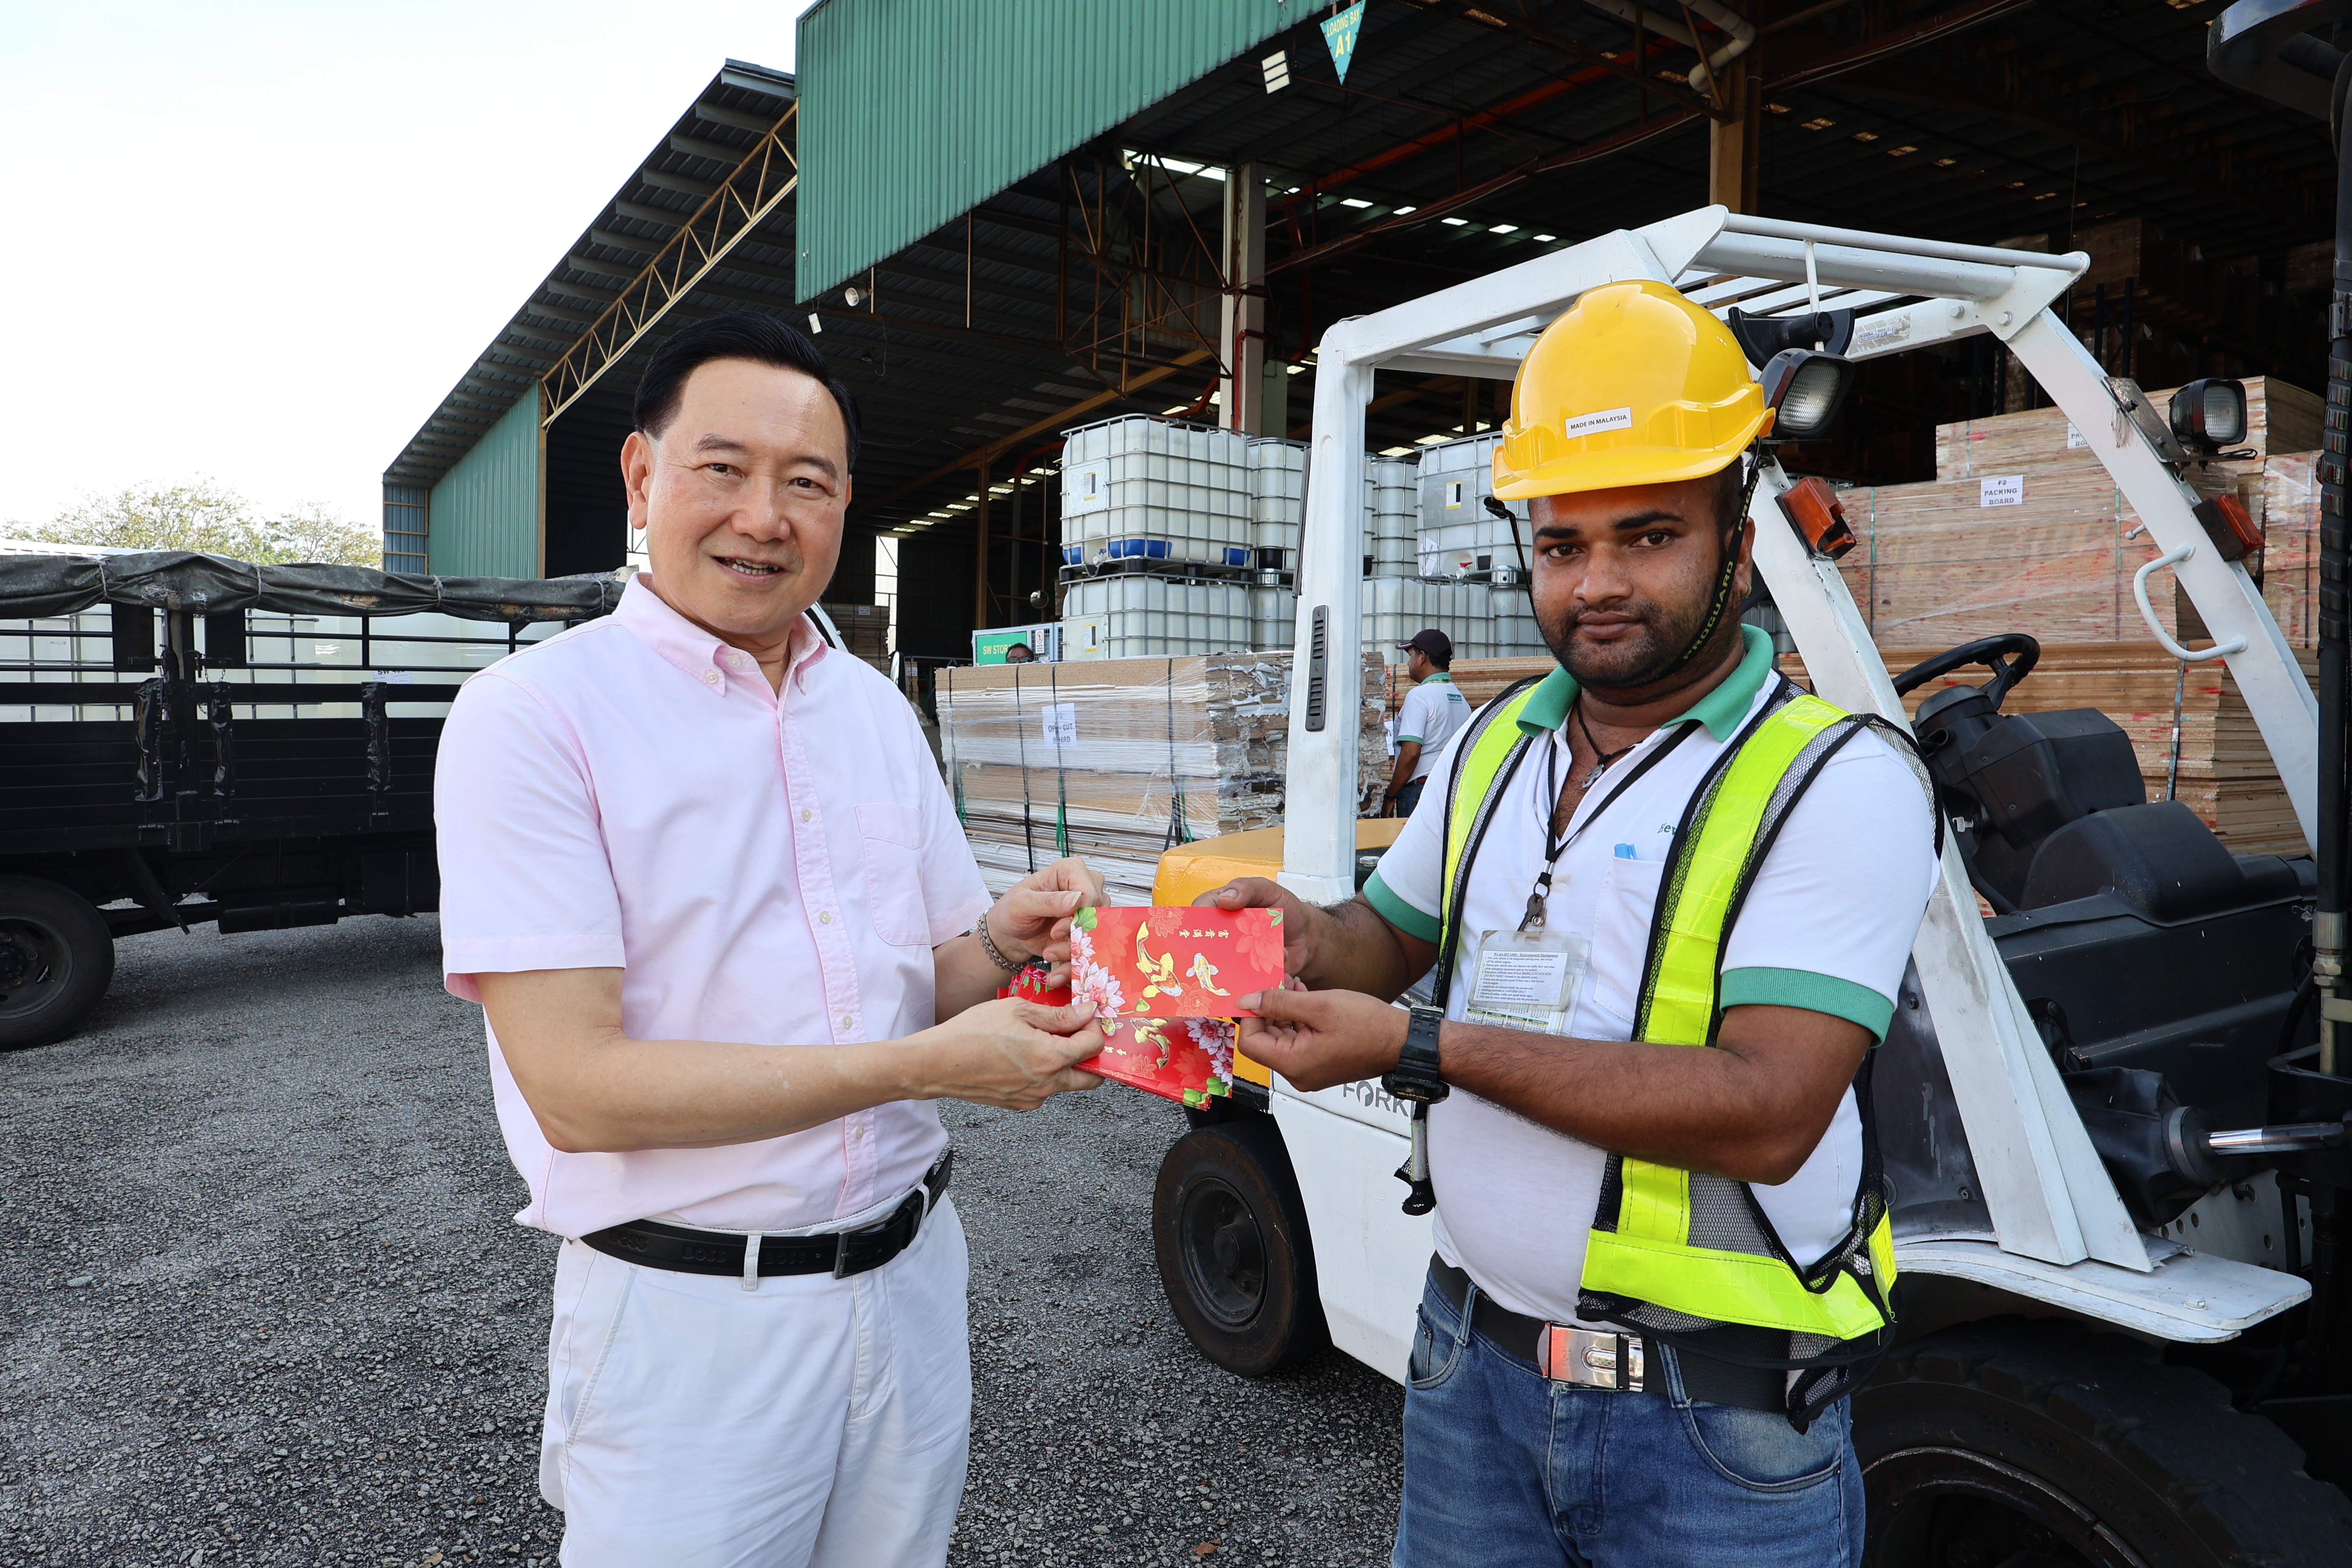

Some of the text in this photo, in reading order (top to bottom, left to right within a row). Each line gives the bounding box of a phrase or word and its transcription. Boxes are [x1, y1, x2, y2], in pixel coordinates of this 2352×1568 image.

[1327, 9, 1361, 37] LOADING BAY
[1335, 31, 1351, 58] A1
[1571, 421, 1587, 430] MADE
[1596, 415, 1627, 424] MALAYSIA
[1984, 488, 2017, 497] PACKING
[983, 643, 1014, 655] SW STOR
[1062, 723, 1073, 731] CUT
[1053, 735, 1071, 744] BARD
[1397, 1091, 1430, 1100] PROTECTION
[610, 1230, 647, 1252] BOSS
[683, 1245, 726, 1262] BOSS
[764, 1252, 806, 1264] BOSS
